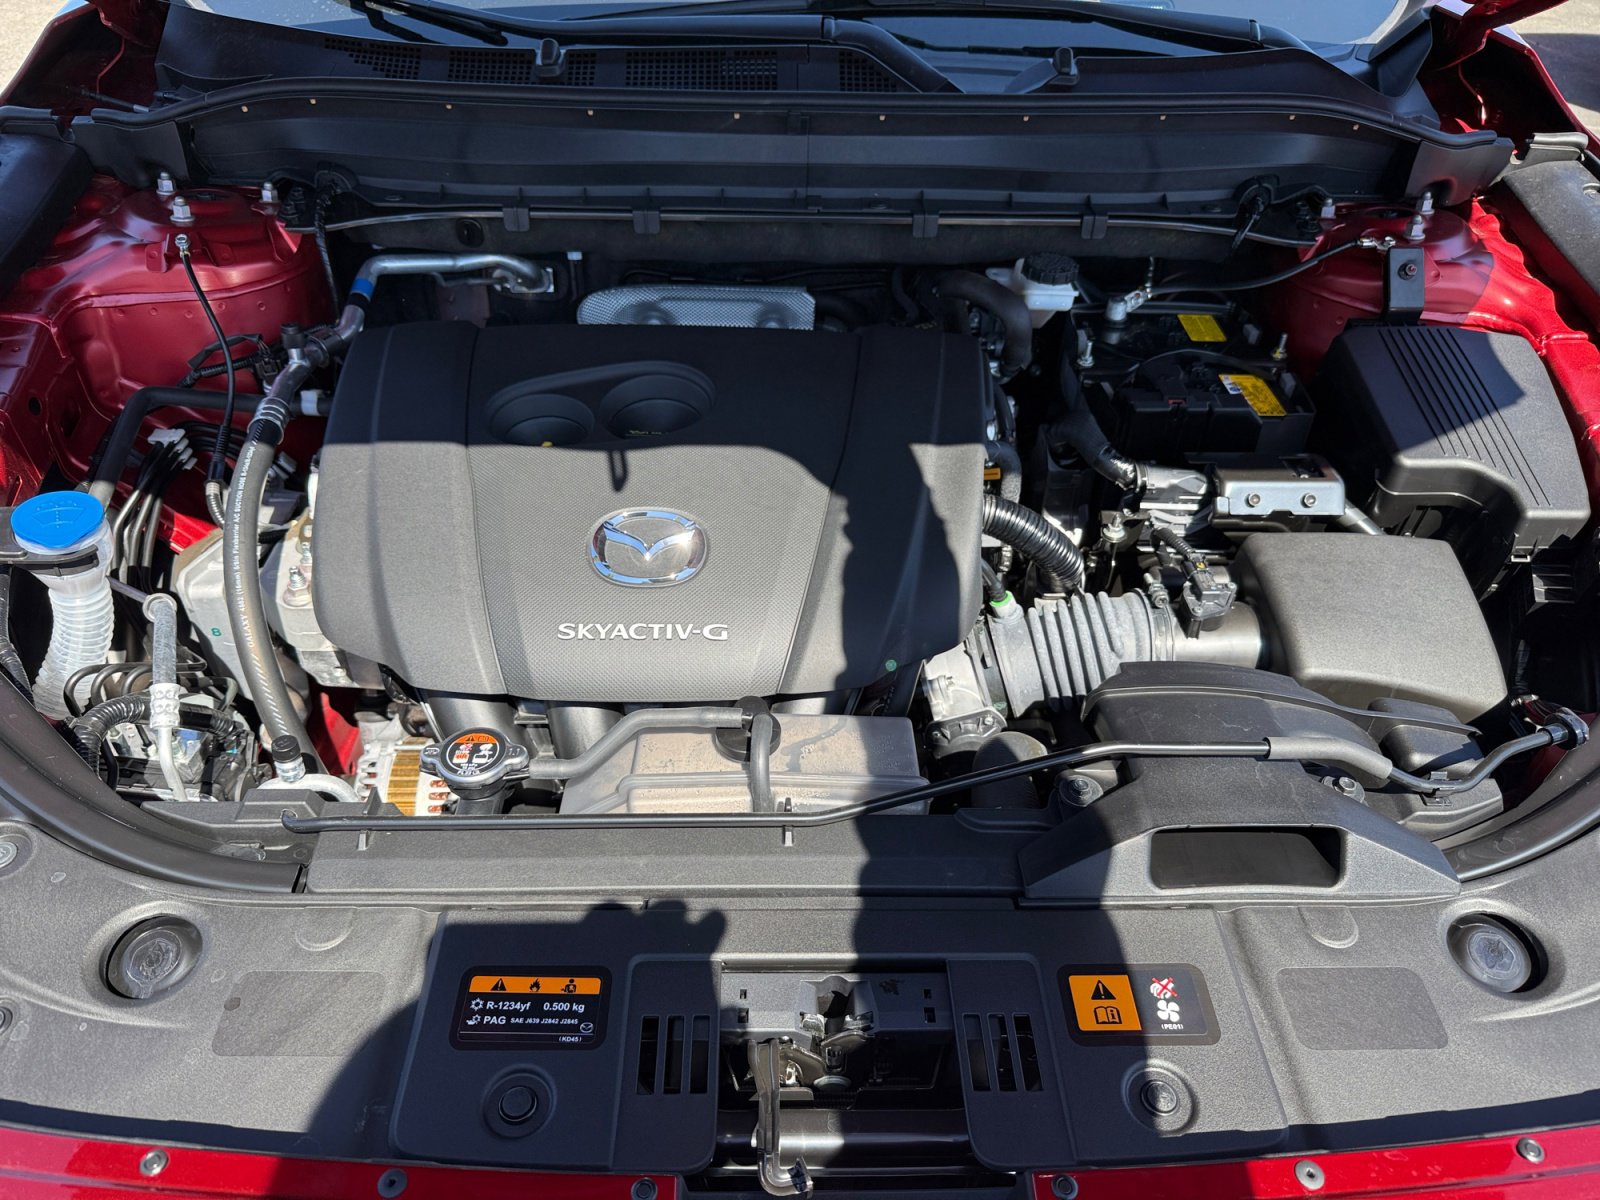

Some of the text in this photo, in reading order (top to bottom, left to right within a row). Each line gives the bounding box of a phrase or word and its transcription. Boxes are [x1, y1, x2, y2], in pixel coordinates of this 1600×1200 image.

[237, 477, 246, 490] HOSE
[234, 490, 244, 512] SUCTION
[557, 622, 729, 641] SKYACTIV-G
[486, 1001, 585, 1013] R-1234yf 0.500 kg
[483, 1015, 506, 1025] PAG
